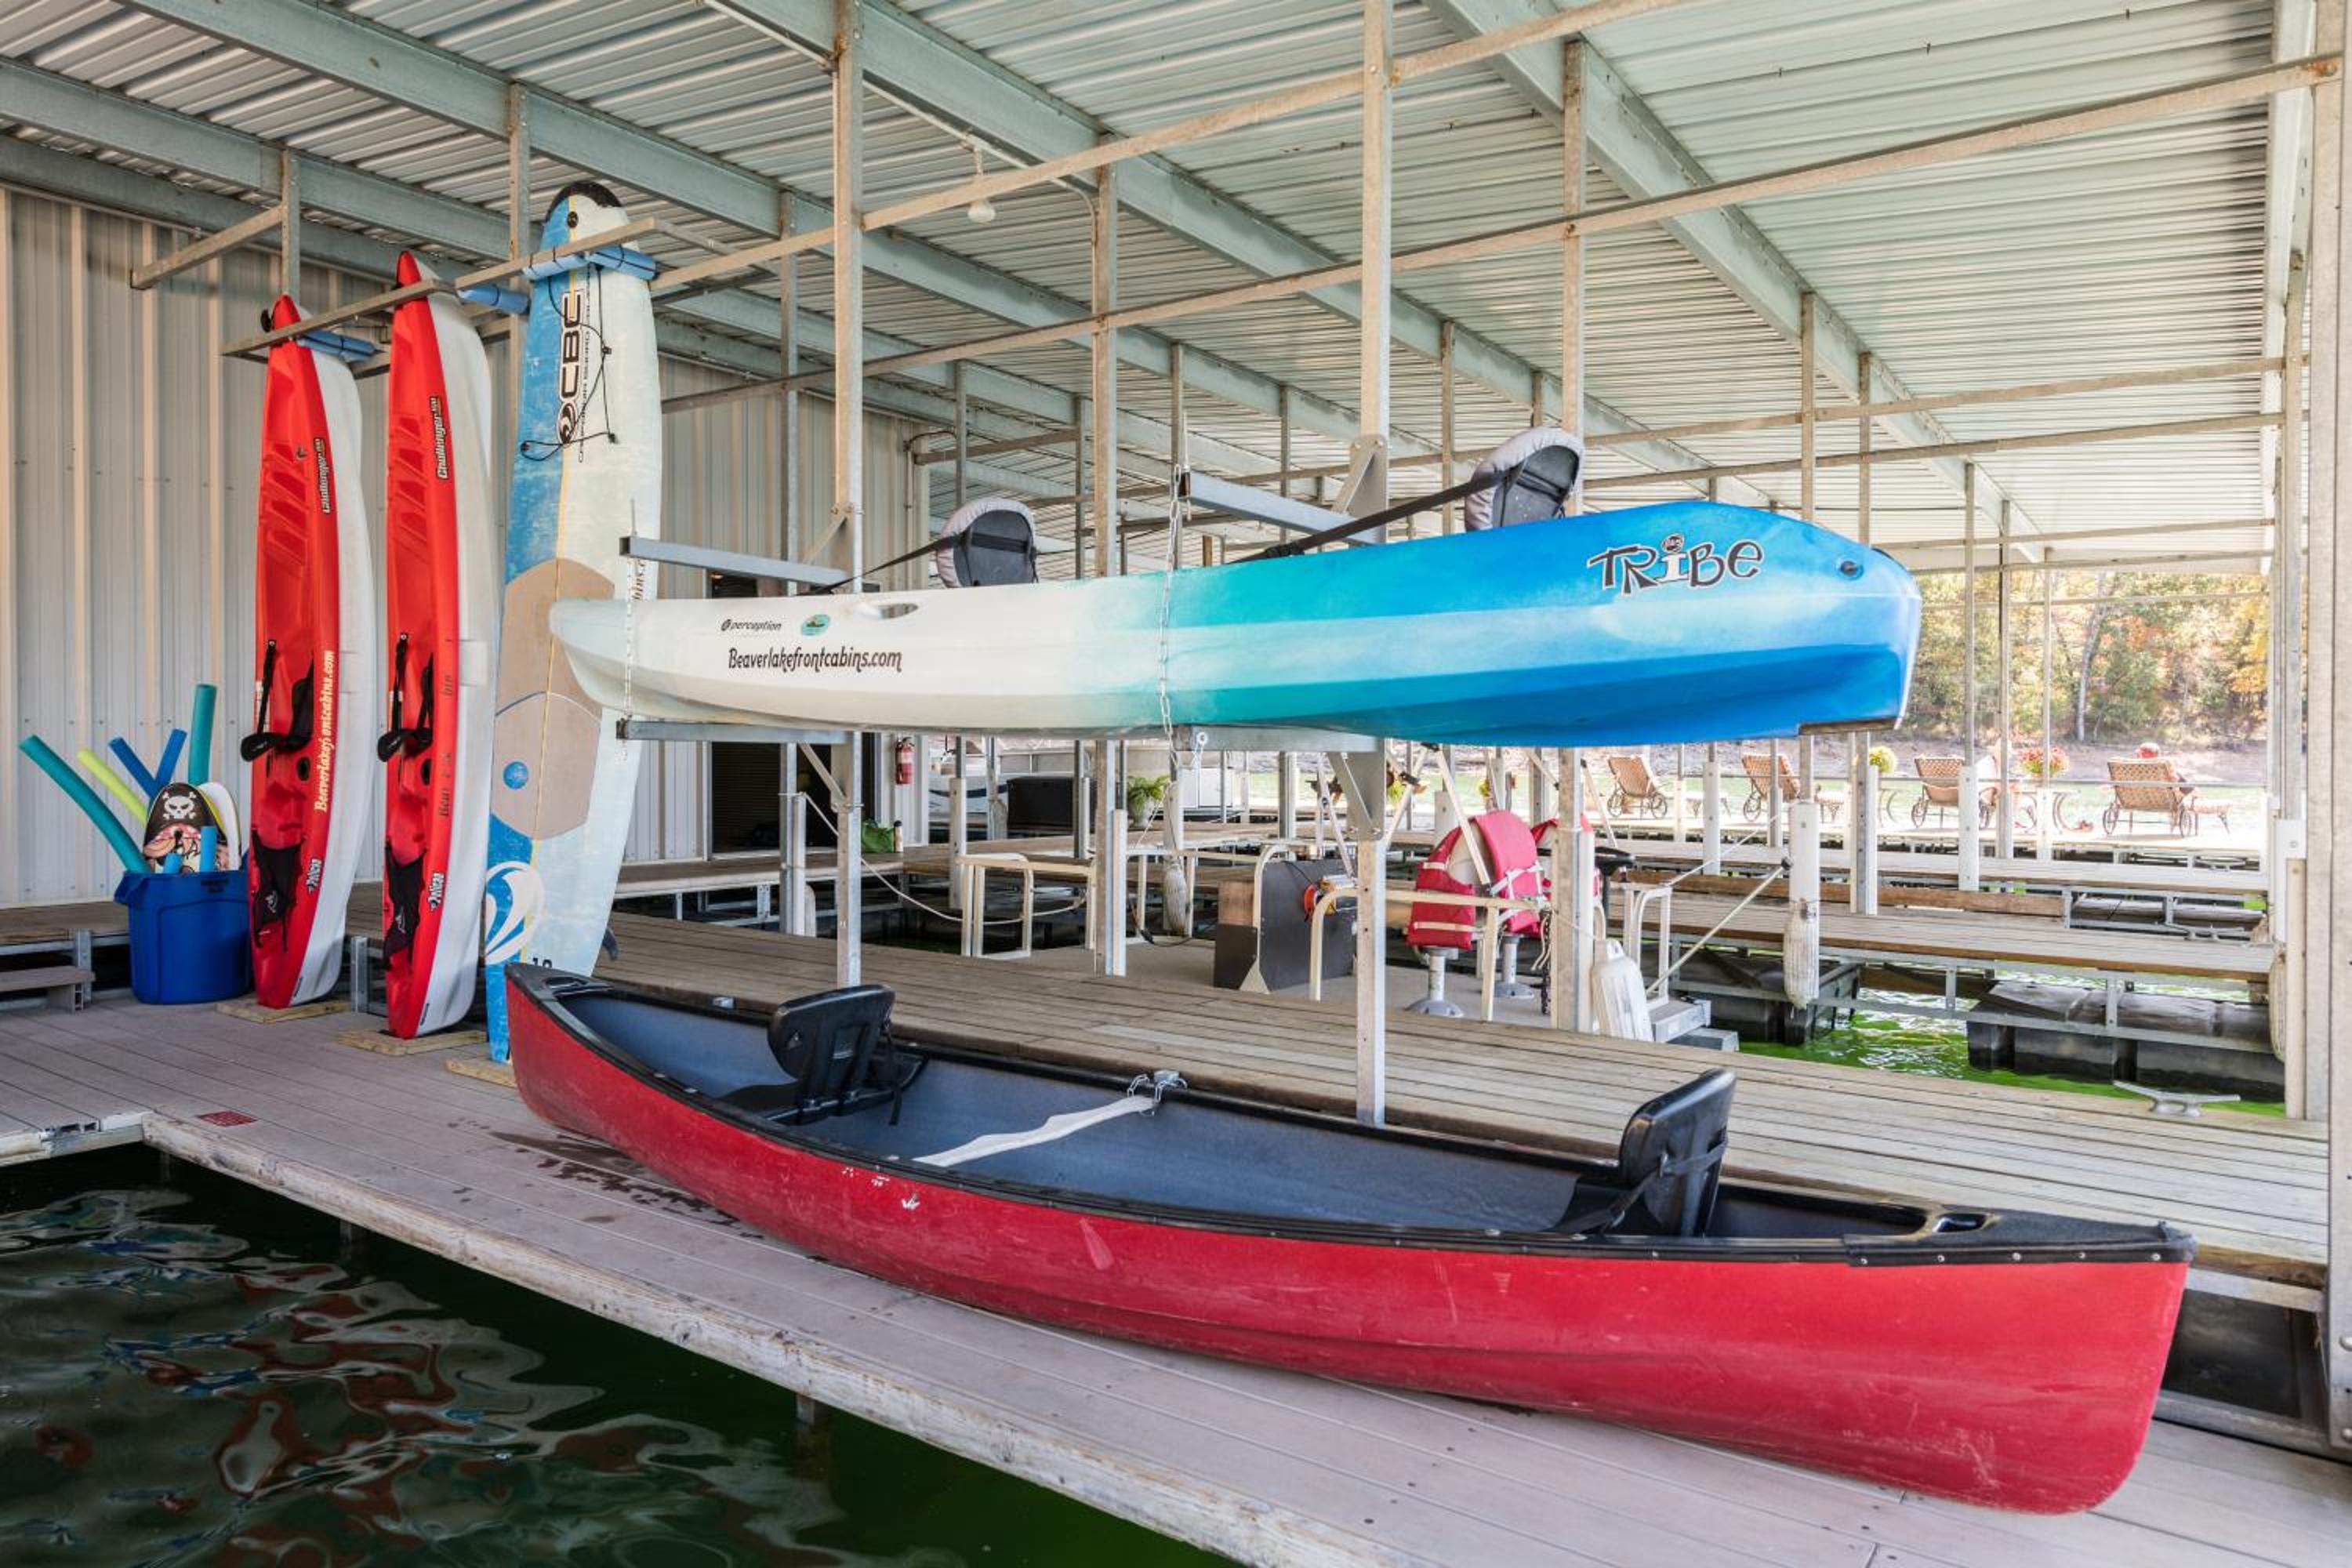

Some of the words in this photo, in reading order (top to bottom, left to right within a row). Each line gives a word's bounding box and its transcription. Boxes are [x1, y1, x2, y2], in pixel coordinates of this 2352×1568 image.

[560, 293, 581, 399] CBC
[731, 620, 782, 632] perception
[728, 646, 902, 673] Beaverlakefrontcabins.com
